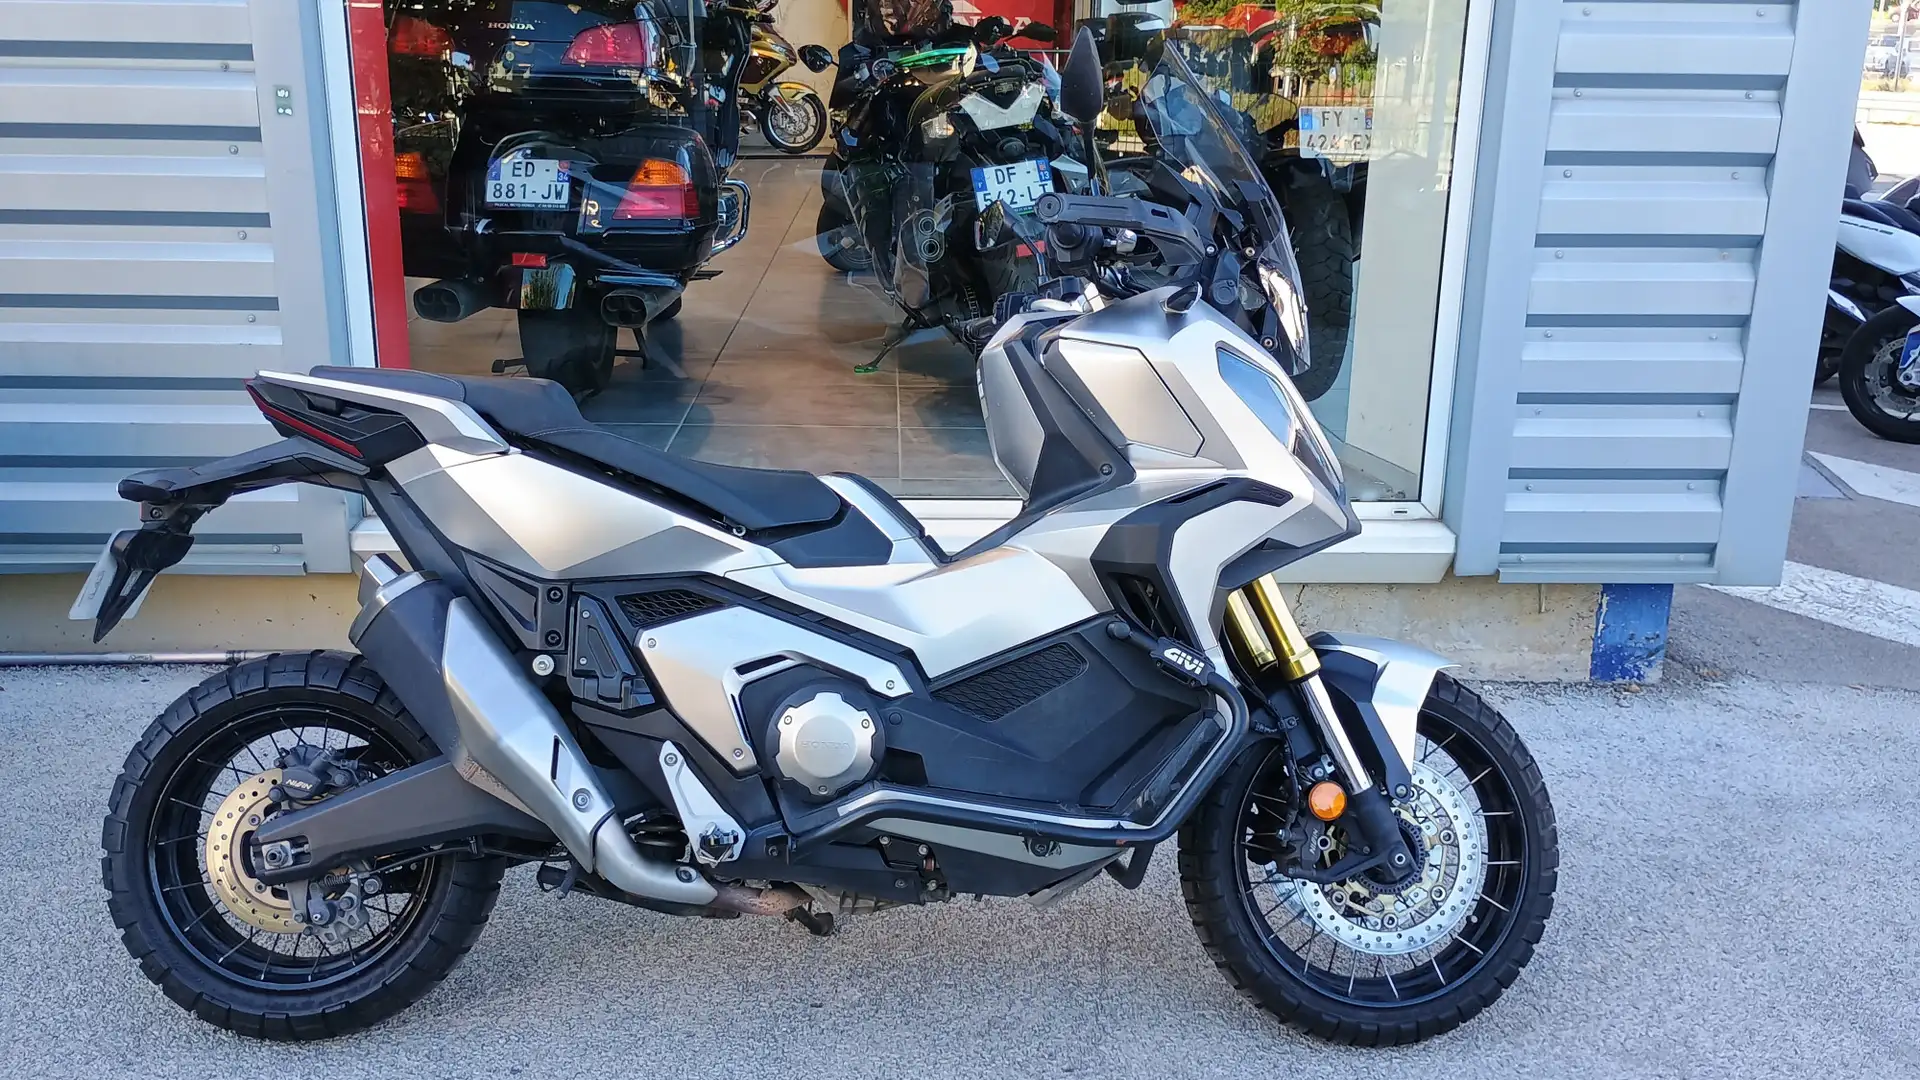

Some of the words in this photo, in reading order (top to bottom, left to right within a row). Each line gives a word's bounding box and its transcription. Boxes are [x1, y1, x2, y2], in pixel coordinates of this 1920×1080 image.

[488, 22, 535, 30] HONDA
[1321, 110, 1343, 127] FY
[512, 161, 535, 178] ED
[558, 172, 568, 181] 34
[994, 166, 1016, 185] DF
[1039, 171, 1050, 180] 13
[1164, 647, 1205, 675] GIVI
